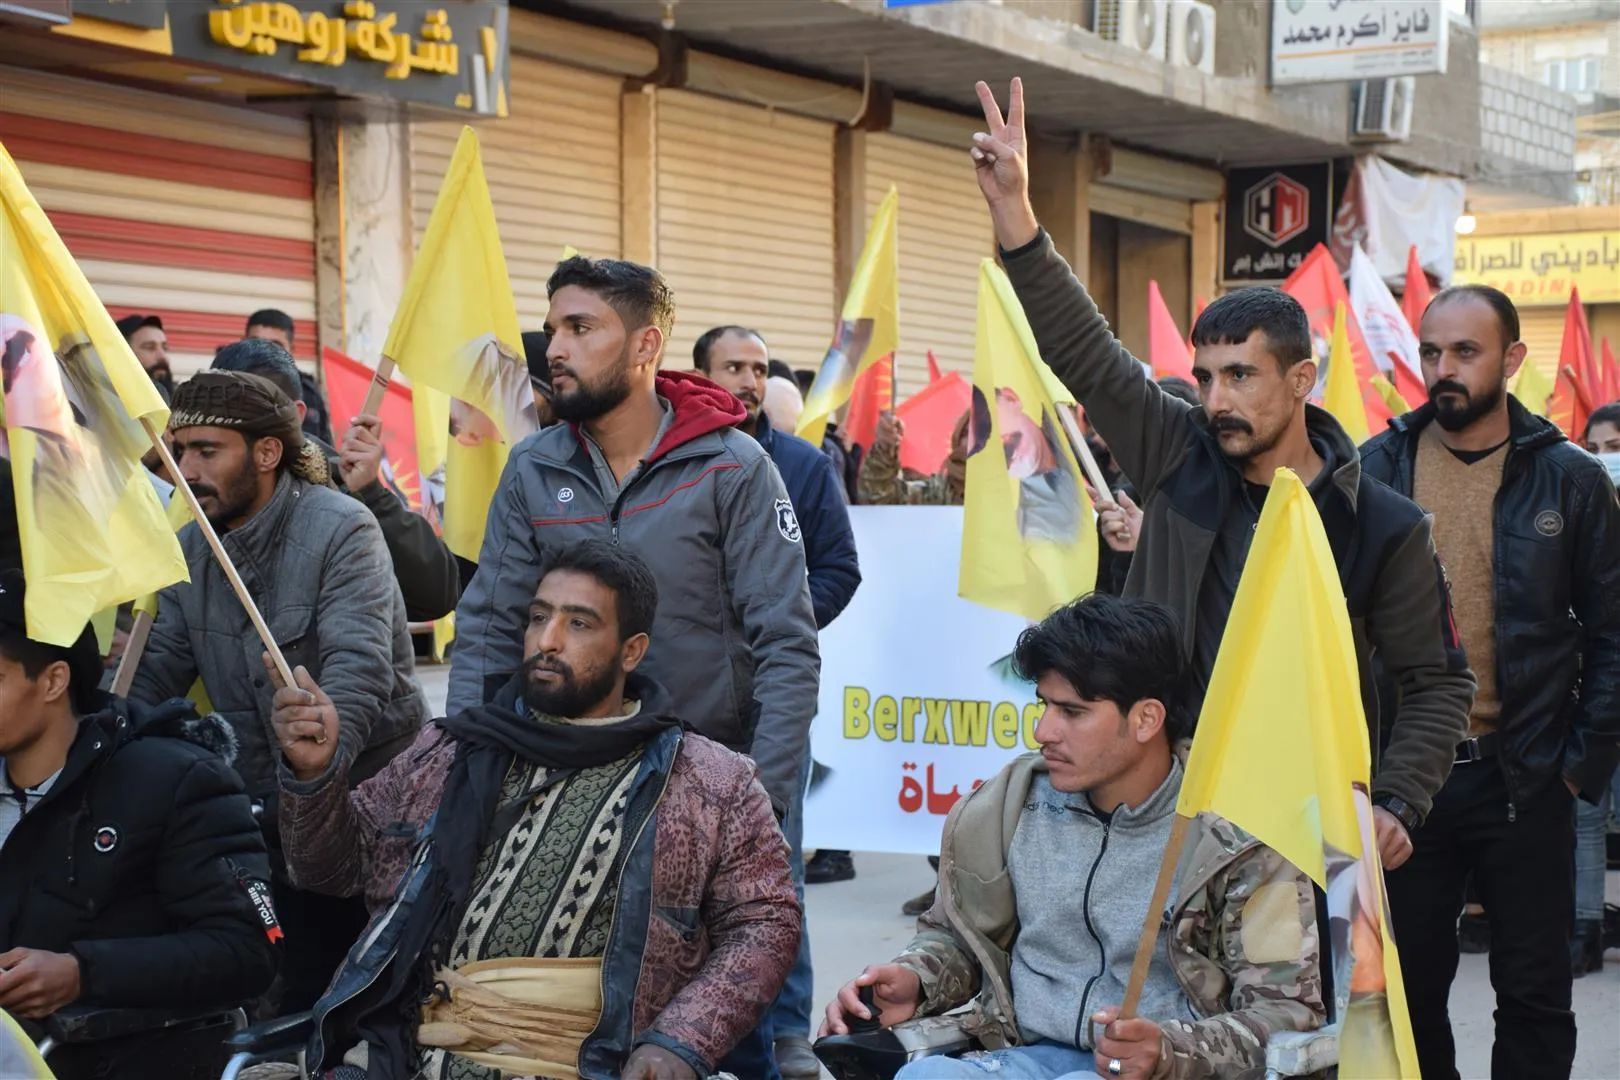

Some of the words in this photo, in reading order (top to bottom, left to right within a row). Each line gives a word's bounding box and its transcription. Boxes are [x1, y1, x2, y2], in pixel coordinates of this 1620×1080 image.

[209, 0, 347, 66] روهين
[346, 0, 459, 79] شركة
[1282, 24, 1332, 46] محمد
[1392, 8, 1430, 43] فايز
[1454, 241, 1523, 276] للصراف
[898, 762, 986, 816] ياة
[247, 886, 262, 906] SEE
[258, 904, 274, 925] YOU
